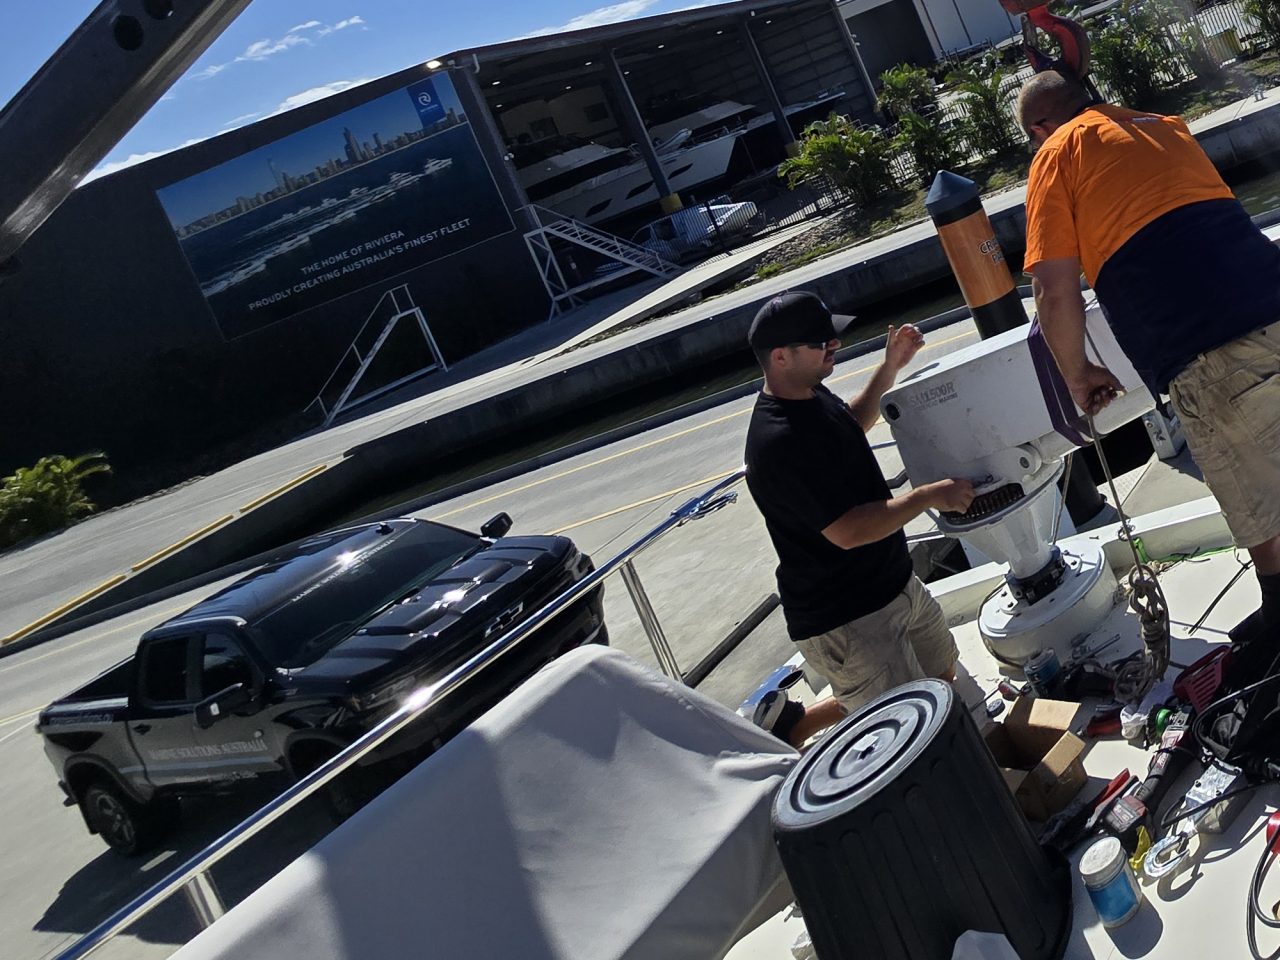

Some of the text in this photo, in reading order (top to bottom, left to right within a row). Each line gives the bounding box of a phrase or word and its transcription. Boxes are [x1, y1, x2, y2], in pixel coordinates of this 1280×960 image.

[249, 218, 470, 311] PROUDLY CREATING AUSTRALIA'S FINEST FLEET
[300, 230, 405, 275] THE HOME OF RIVIERA
[221, 739, 268, 754] AUSTRALIA
